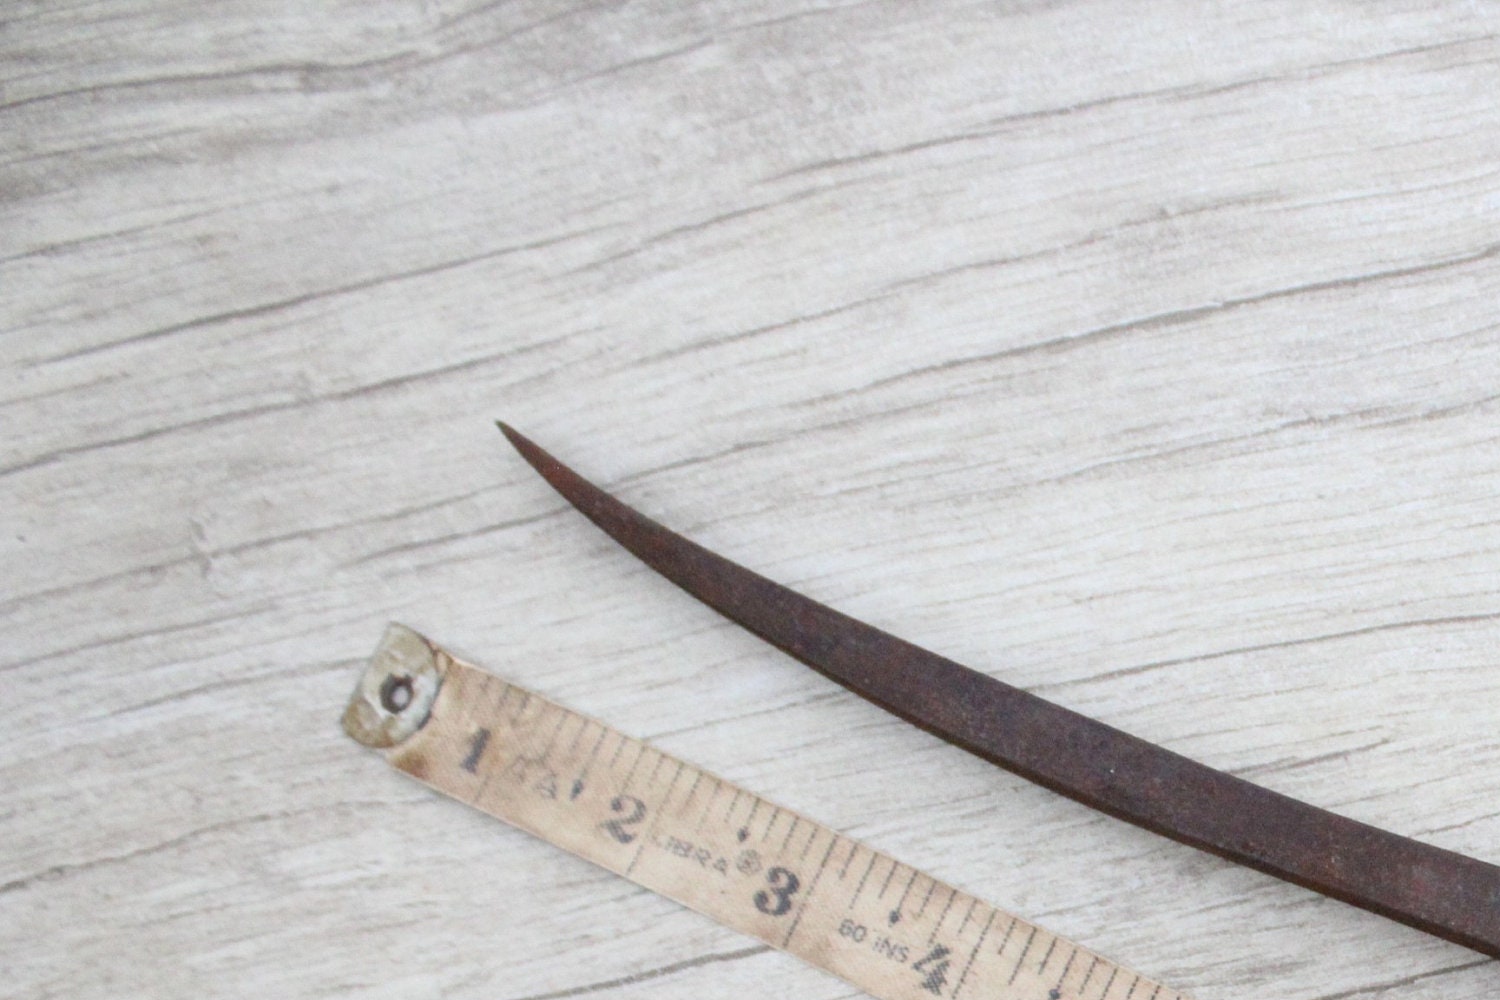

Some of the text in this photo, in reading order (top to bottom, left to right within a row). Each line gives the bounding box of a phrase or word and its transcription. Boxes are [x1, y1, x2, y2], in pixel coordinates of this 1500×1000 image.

[459, 726, 492, 775] 1
[597, 794, 648, 845] 2
[753, 867, 801, 916] 3
[911, 943, 952, 996] 4
